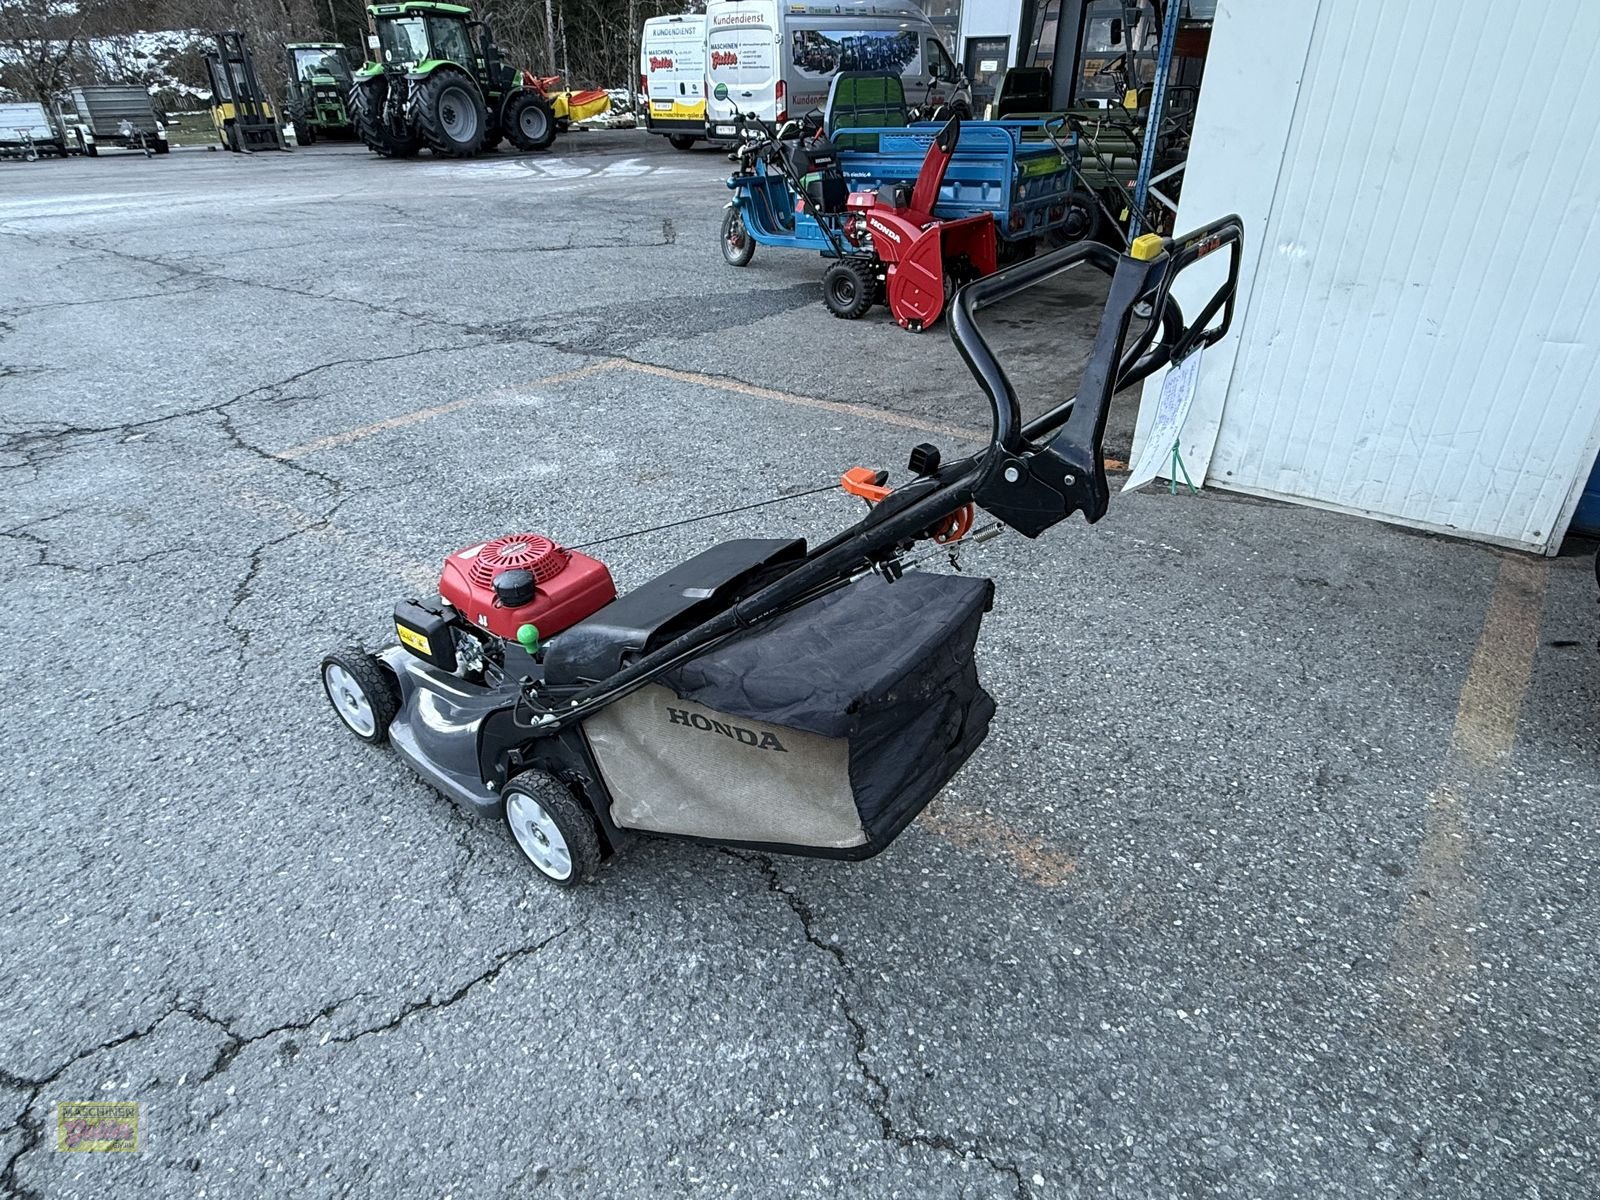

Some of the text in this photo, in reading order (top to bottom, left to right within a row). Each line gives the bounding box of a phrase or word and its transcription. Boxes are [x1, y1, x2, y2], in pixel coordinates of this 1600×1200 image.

[713, 13, 764, 25] Kundendienst
[653, 27, 696, 36] KUNDENDIENST
[870, 218, 901, 243] HONDA
[666, 707, 788, 752] HONDA
